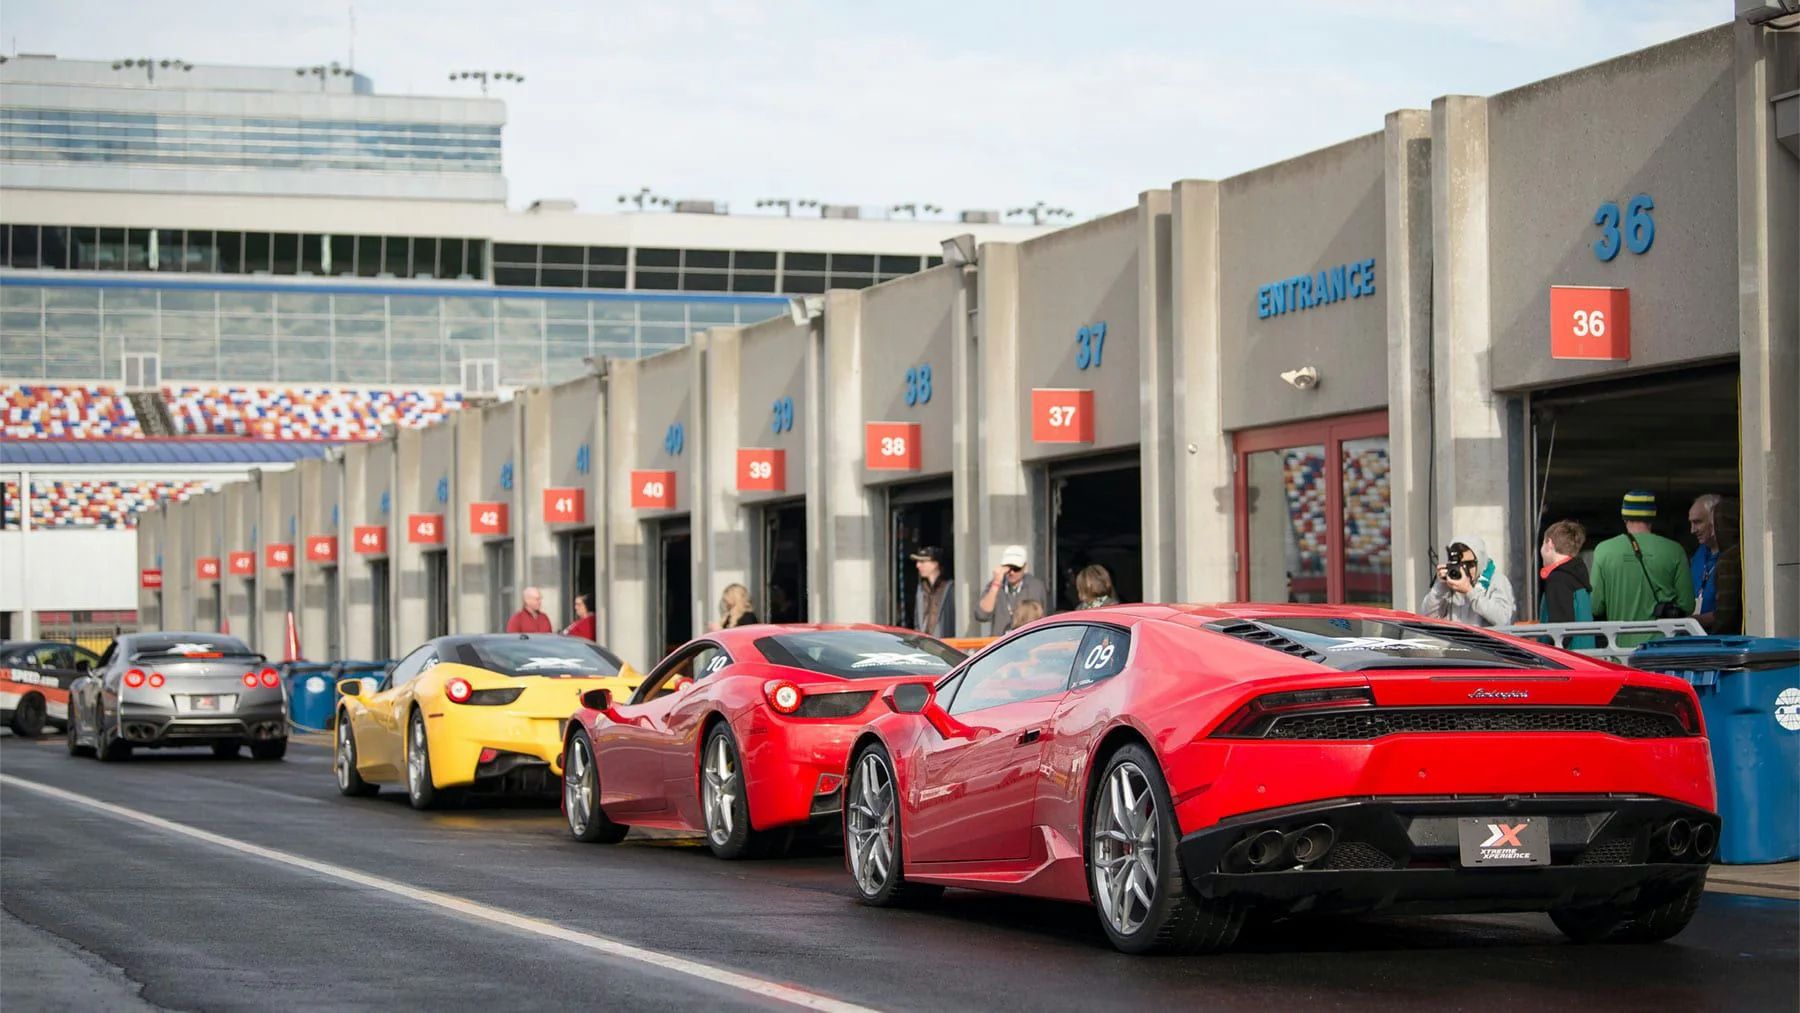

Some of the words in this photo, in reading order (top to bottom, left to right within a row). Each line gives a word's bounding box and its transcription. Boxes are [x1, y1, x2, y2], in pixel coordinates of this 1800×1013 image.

[1593, 194, 1656, 262] 36
[1257, 257, 1377, 319] ENTRANCE
[1572, 309, 1606, 337] 36
[1075, 322, 1108, 370] 37
[904, 363, 933, 407] 38
[772, 396, 794, 434] 39
[1048, 405, 1077, 427] 37
[664, 422, 685, 456] 40
[880, 436, 906, 457] 38
[749, 461, 772, 480] 39
[642, 482, 665, 498] 40
[555, 497, 574, 513] 41
[479, 511, 499, 526] 42
[361, 533, 379, 546] 44
[417, 522, 435, 537] 43
[706, 655, 728, 672] 10
[1083, 644, 1116, 670] 09
[1483, 852, 1531, 860] XPERIENCE
